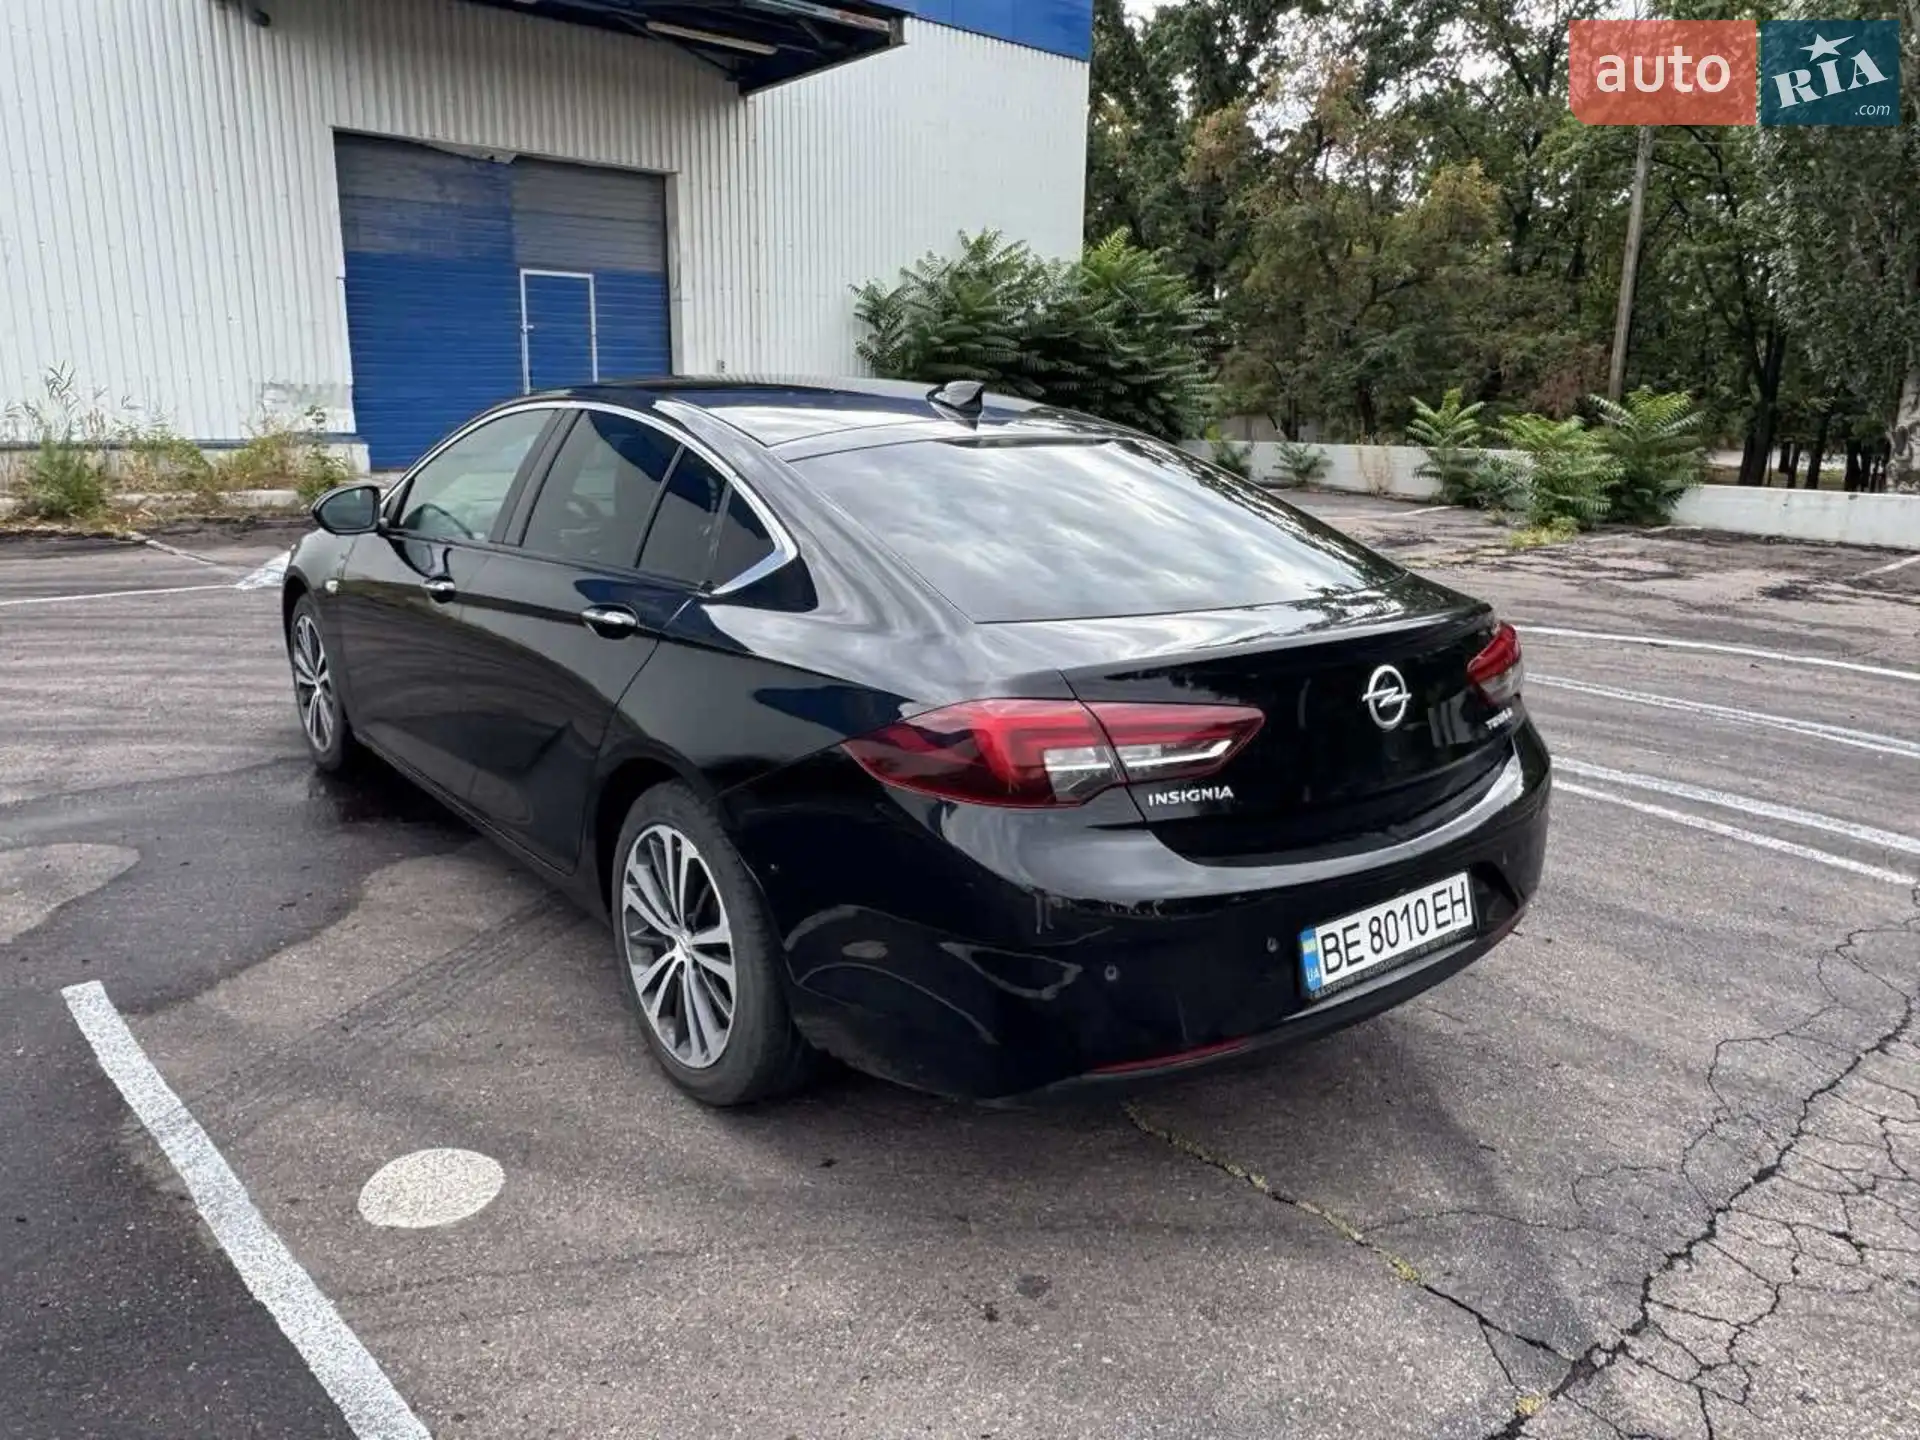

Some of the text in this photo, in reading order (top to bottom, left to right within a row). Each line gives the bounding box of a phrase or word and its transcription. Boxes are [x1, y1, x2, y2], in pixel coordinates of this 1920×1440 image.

[1148, 785, 1234, 807] INSIGNIA
[1320, 922, 1365, 975] BE
[1368, 898, 1429, 955] 8010
[1432, 881, 1468, 930] EH
[1306, 966, 1321, 983] UA
